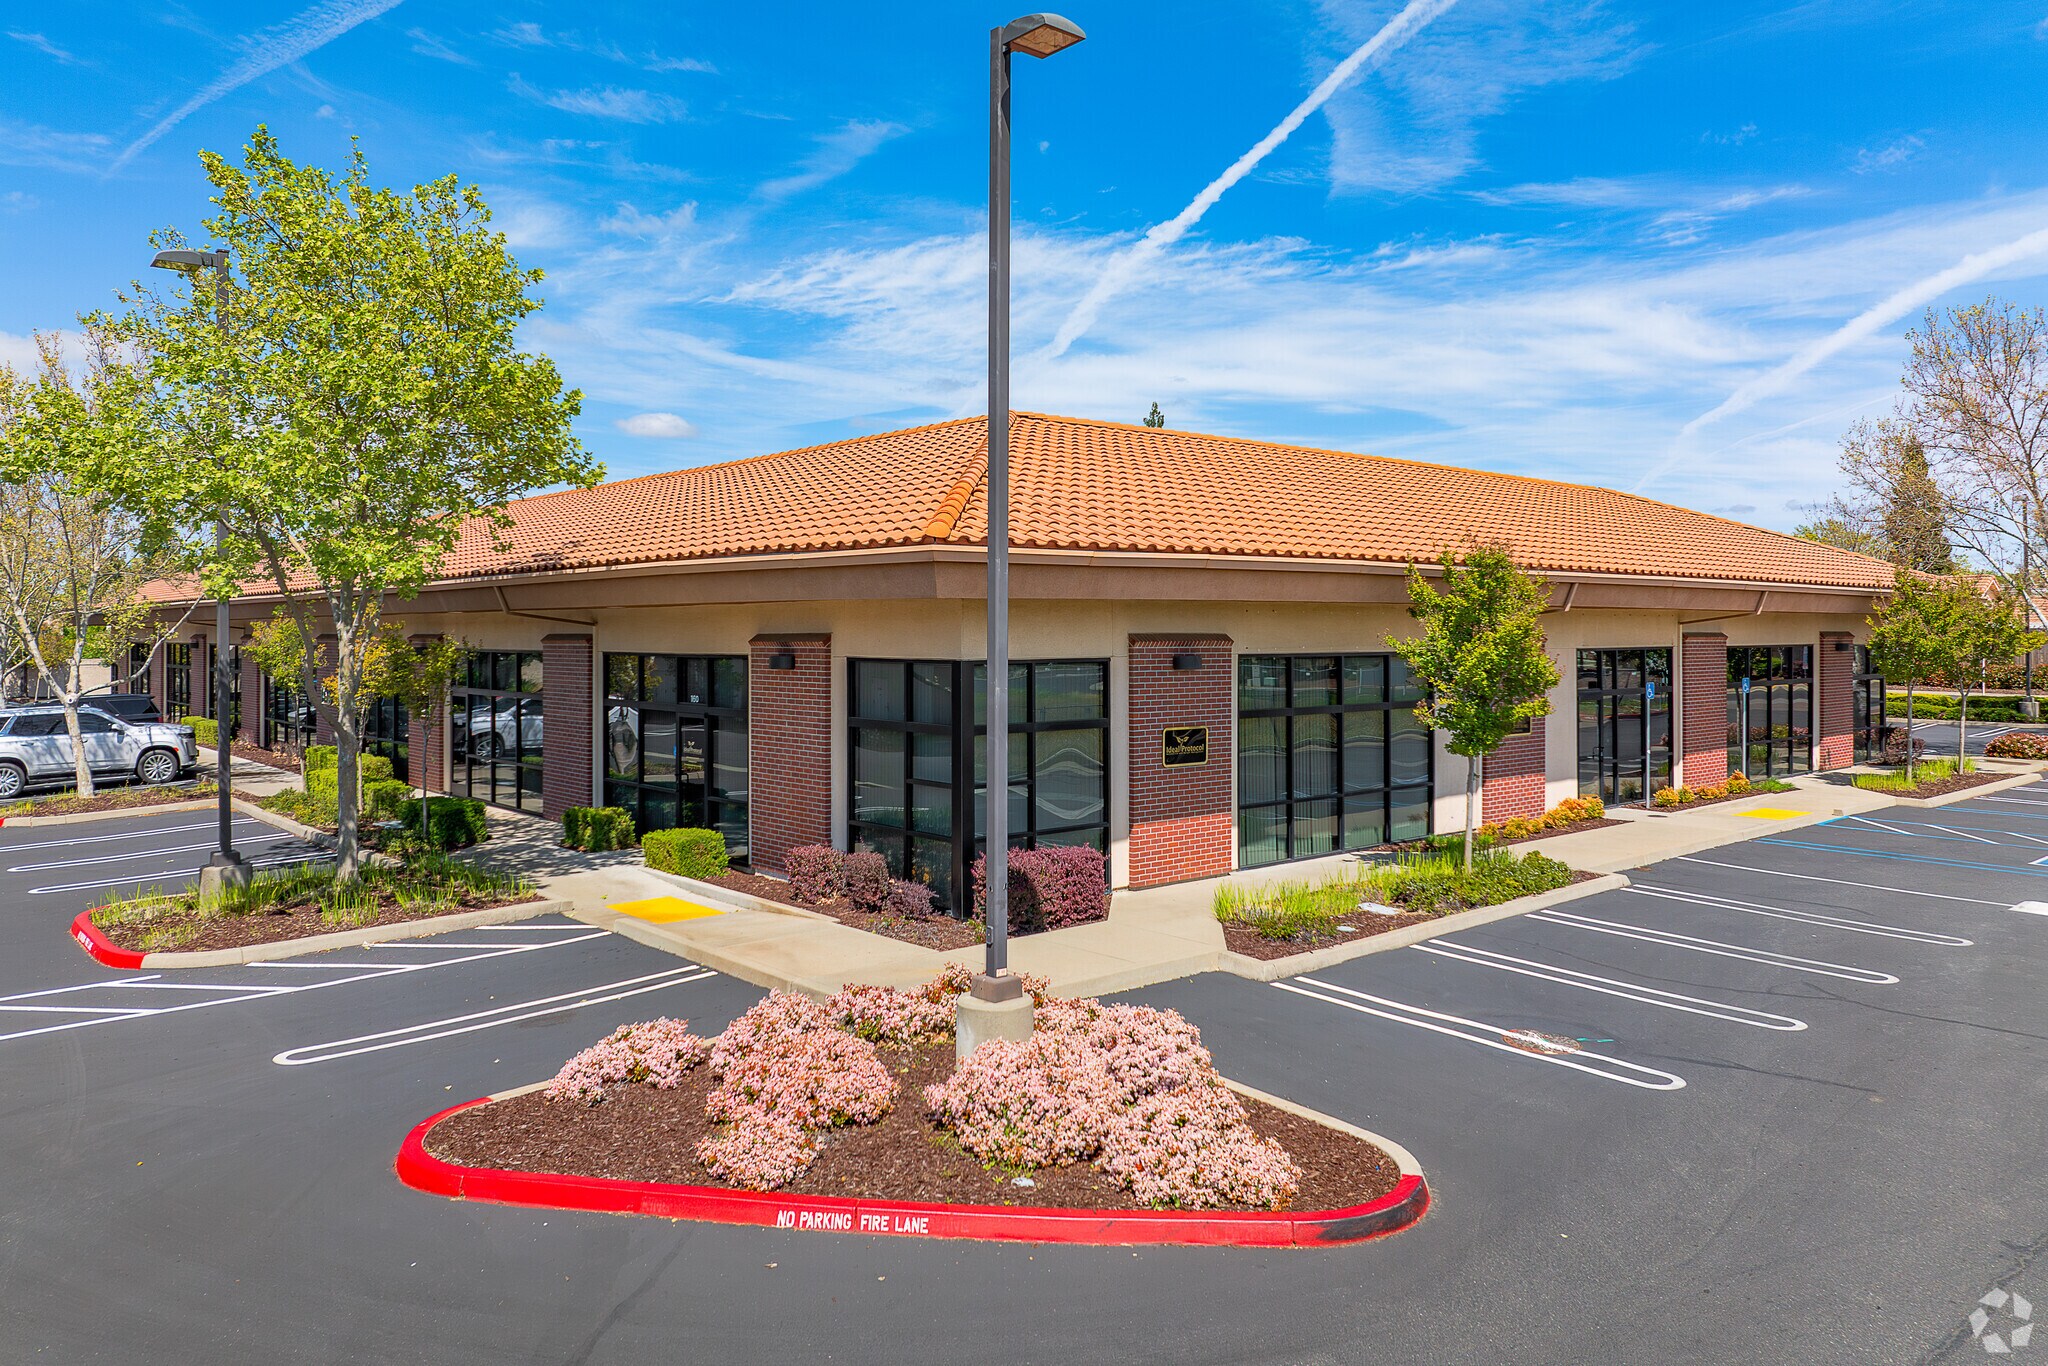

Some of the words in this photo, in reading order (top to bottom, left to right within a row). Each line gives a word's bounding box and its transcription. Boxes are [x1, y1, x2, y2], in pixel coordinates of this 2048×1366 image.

[690, 695, 700, 703] 160
[1166, 745, 1180, 754] Ideal
[1181, 744, 1205, 752] Protocol
[777, 1210, 795, 1227] NO
[799, 1211, 852, 1230] PARKING
[860, 1214, 890, 1231] FIRE
[894, 1216, 929, 1234] LANE
